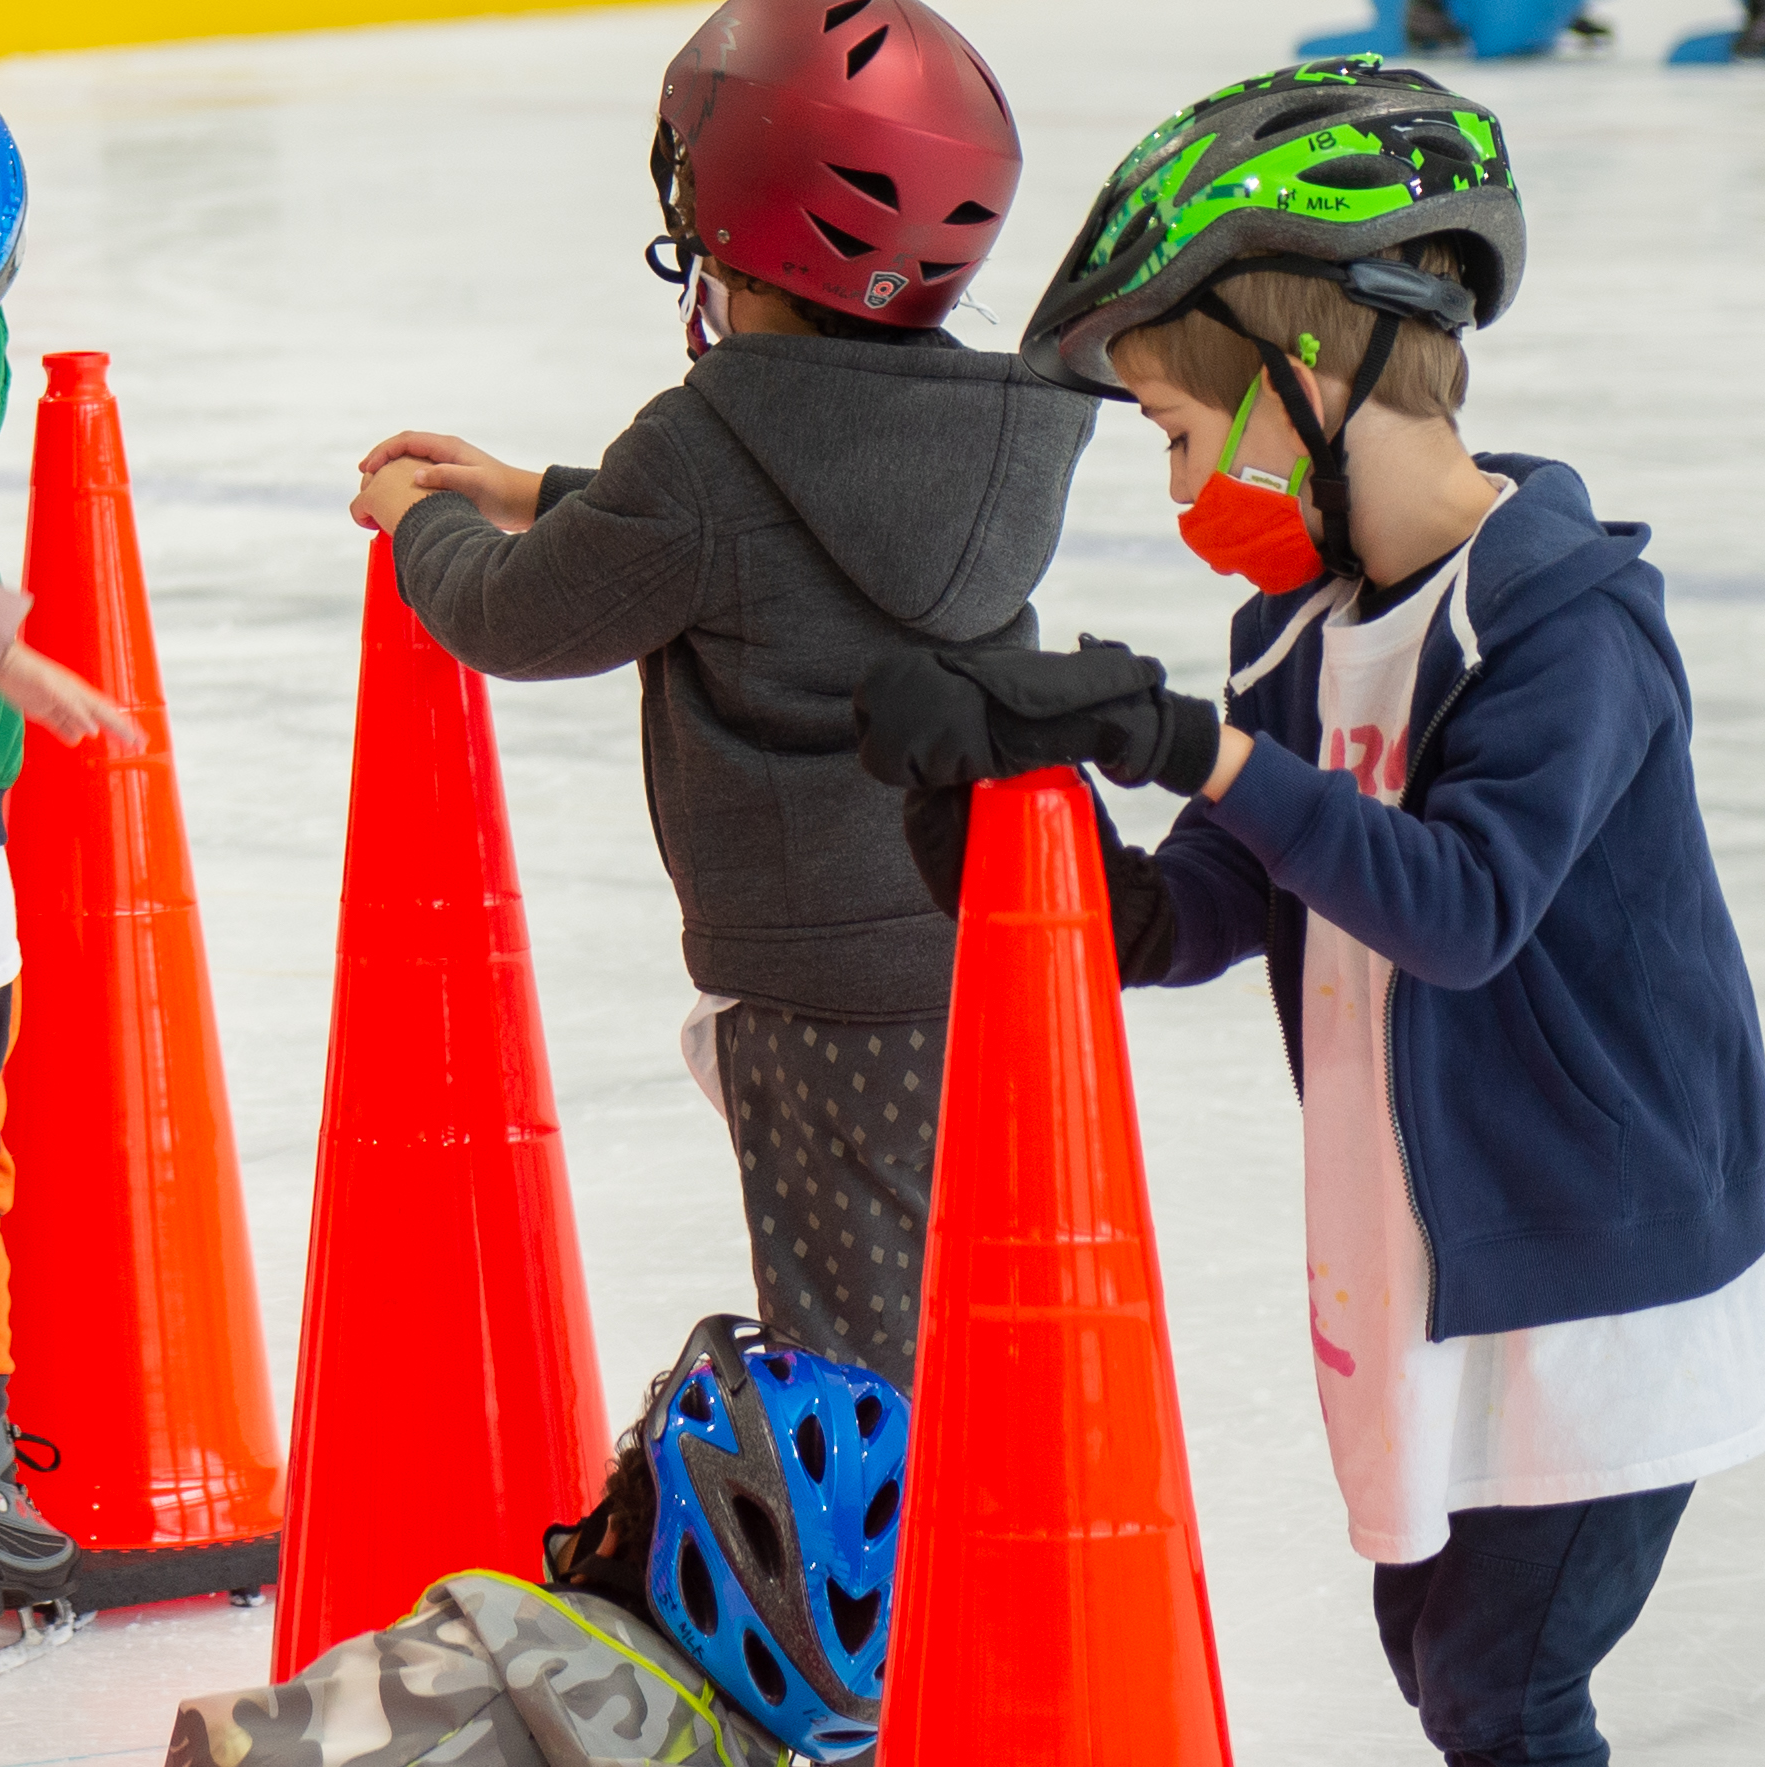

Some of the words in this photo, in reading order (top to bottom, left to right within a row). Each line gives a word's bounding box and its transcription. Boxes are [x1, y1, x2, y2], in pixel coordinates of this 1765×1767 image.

[1308, 131, 1337, 153] 18
[1306, 196, 1351, 211] MLK
[677, 1621, 705, 1661] MLK
